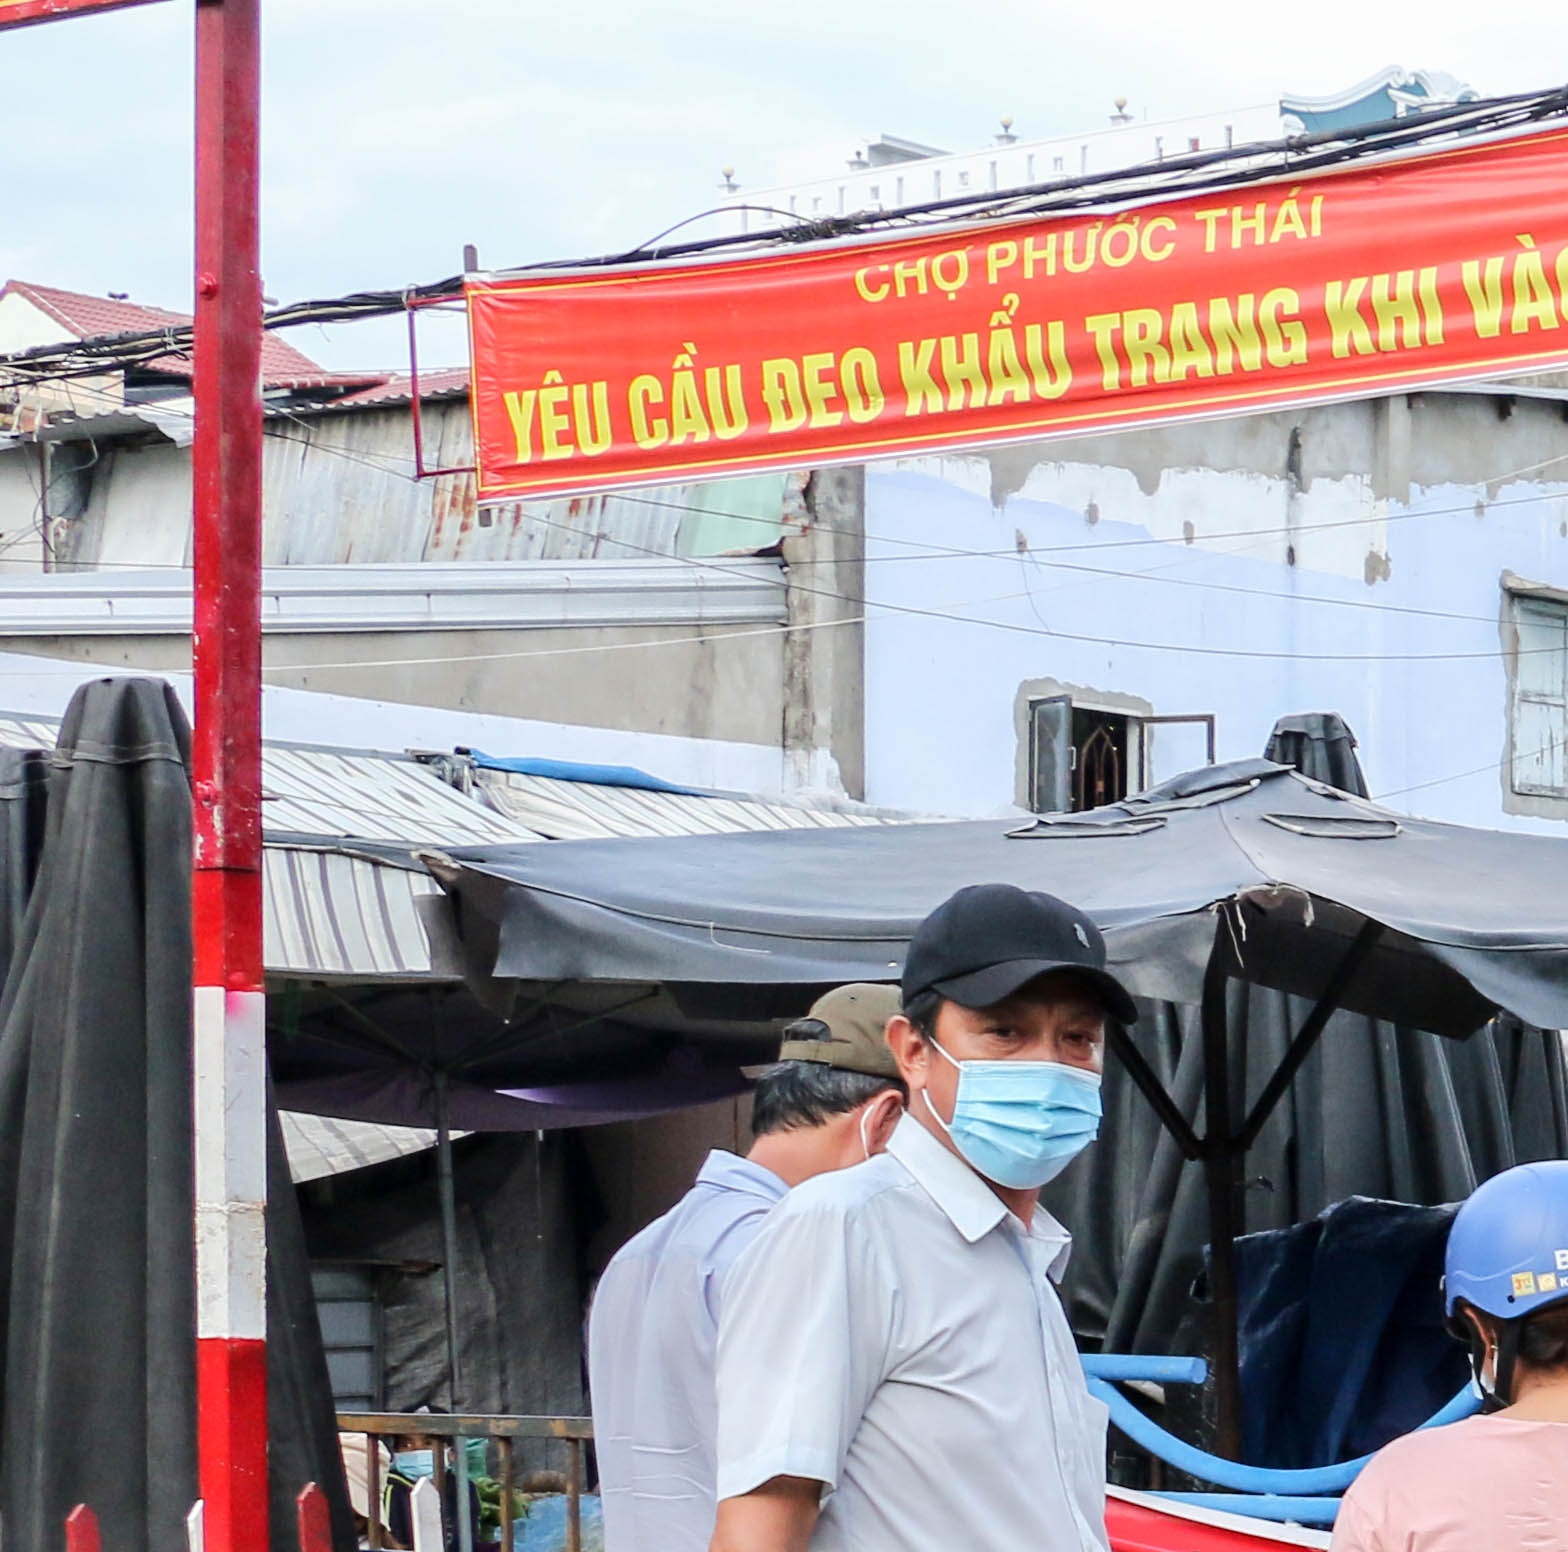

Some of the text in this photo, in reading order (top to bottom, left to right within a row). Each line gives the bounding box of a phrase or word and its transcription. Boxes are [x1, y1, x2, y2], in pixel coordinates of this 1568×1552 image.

[854, 187, 1325, 302] CHỢ PHƯỚC THÁI
[502, 367, 614, 464] YÊU
[627, 342, 751, 450] CẦU
[760, 346, 887, 433] ĐEO
[897, 292, 1074, 418] KHẨU
[1084, 286, 1310, 391] TRANG
[1323, 265, 1445, 359] KHI
